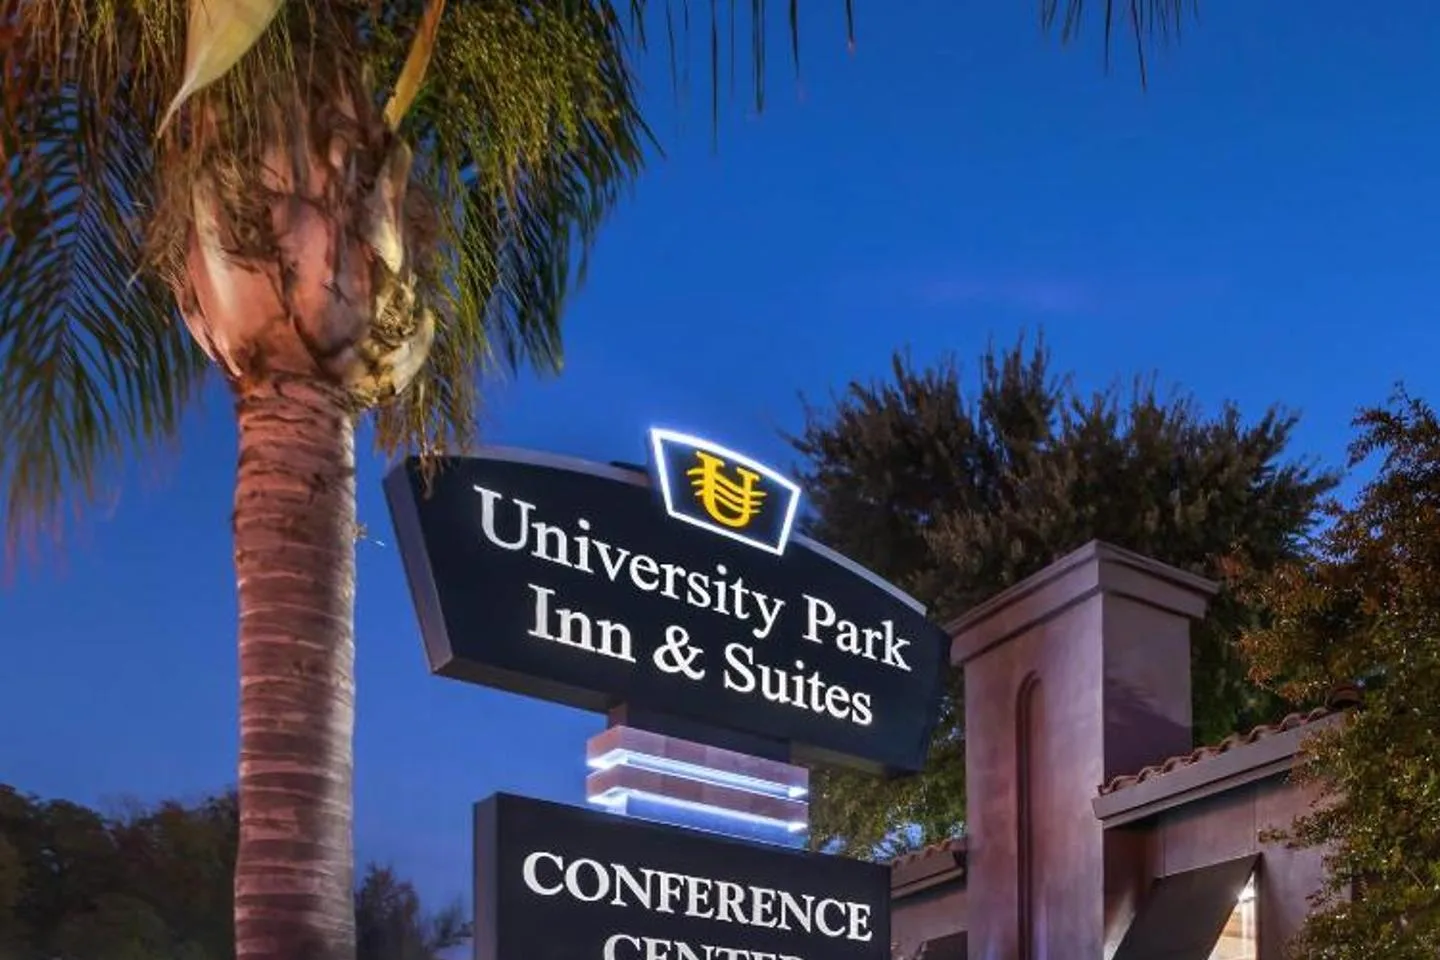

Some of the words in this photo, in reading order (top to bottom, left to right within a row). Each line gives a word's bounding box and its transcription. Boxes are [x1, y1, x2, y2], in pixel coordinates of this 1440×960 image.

[473, 485, 785, 639] University
[802, 594, 912, 672] Park
[527, 583, 636, 664] Inn
[653, 625, 706, 681] &
[723, 642, 873, 725] Suites
[522, 851, 873, 942] CONFERENCE
